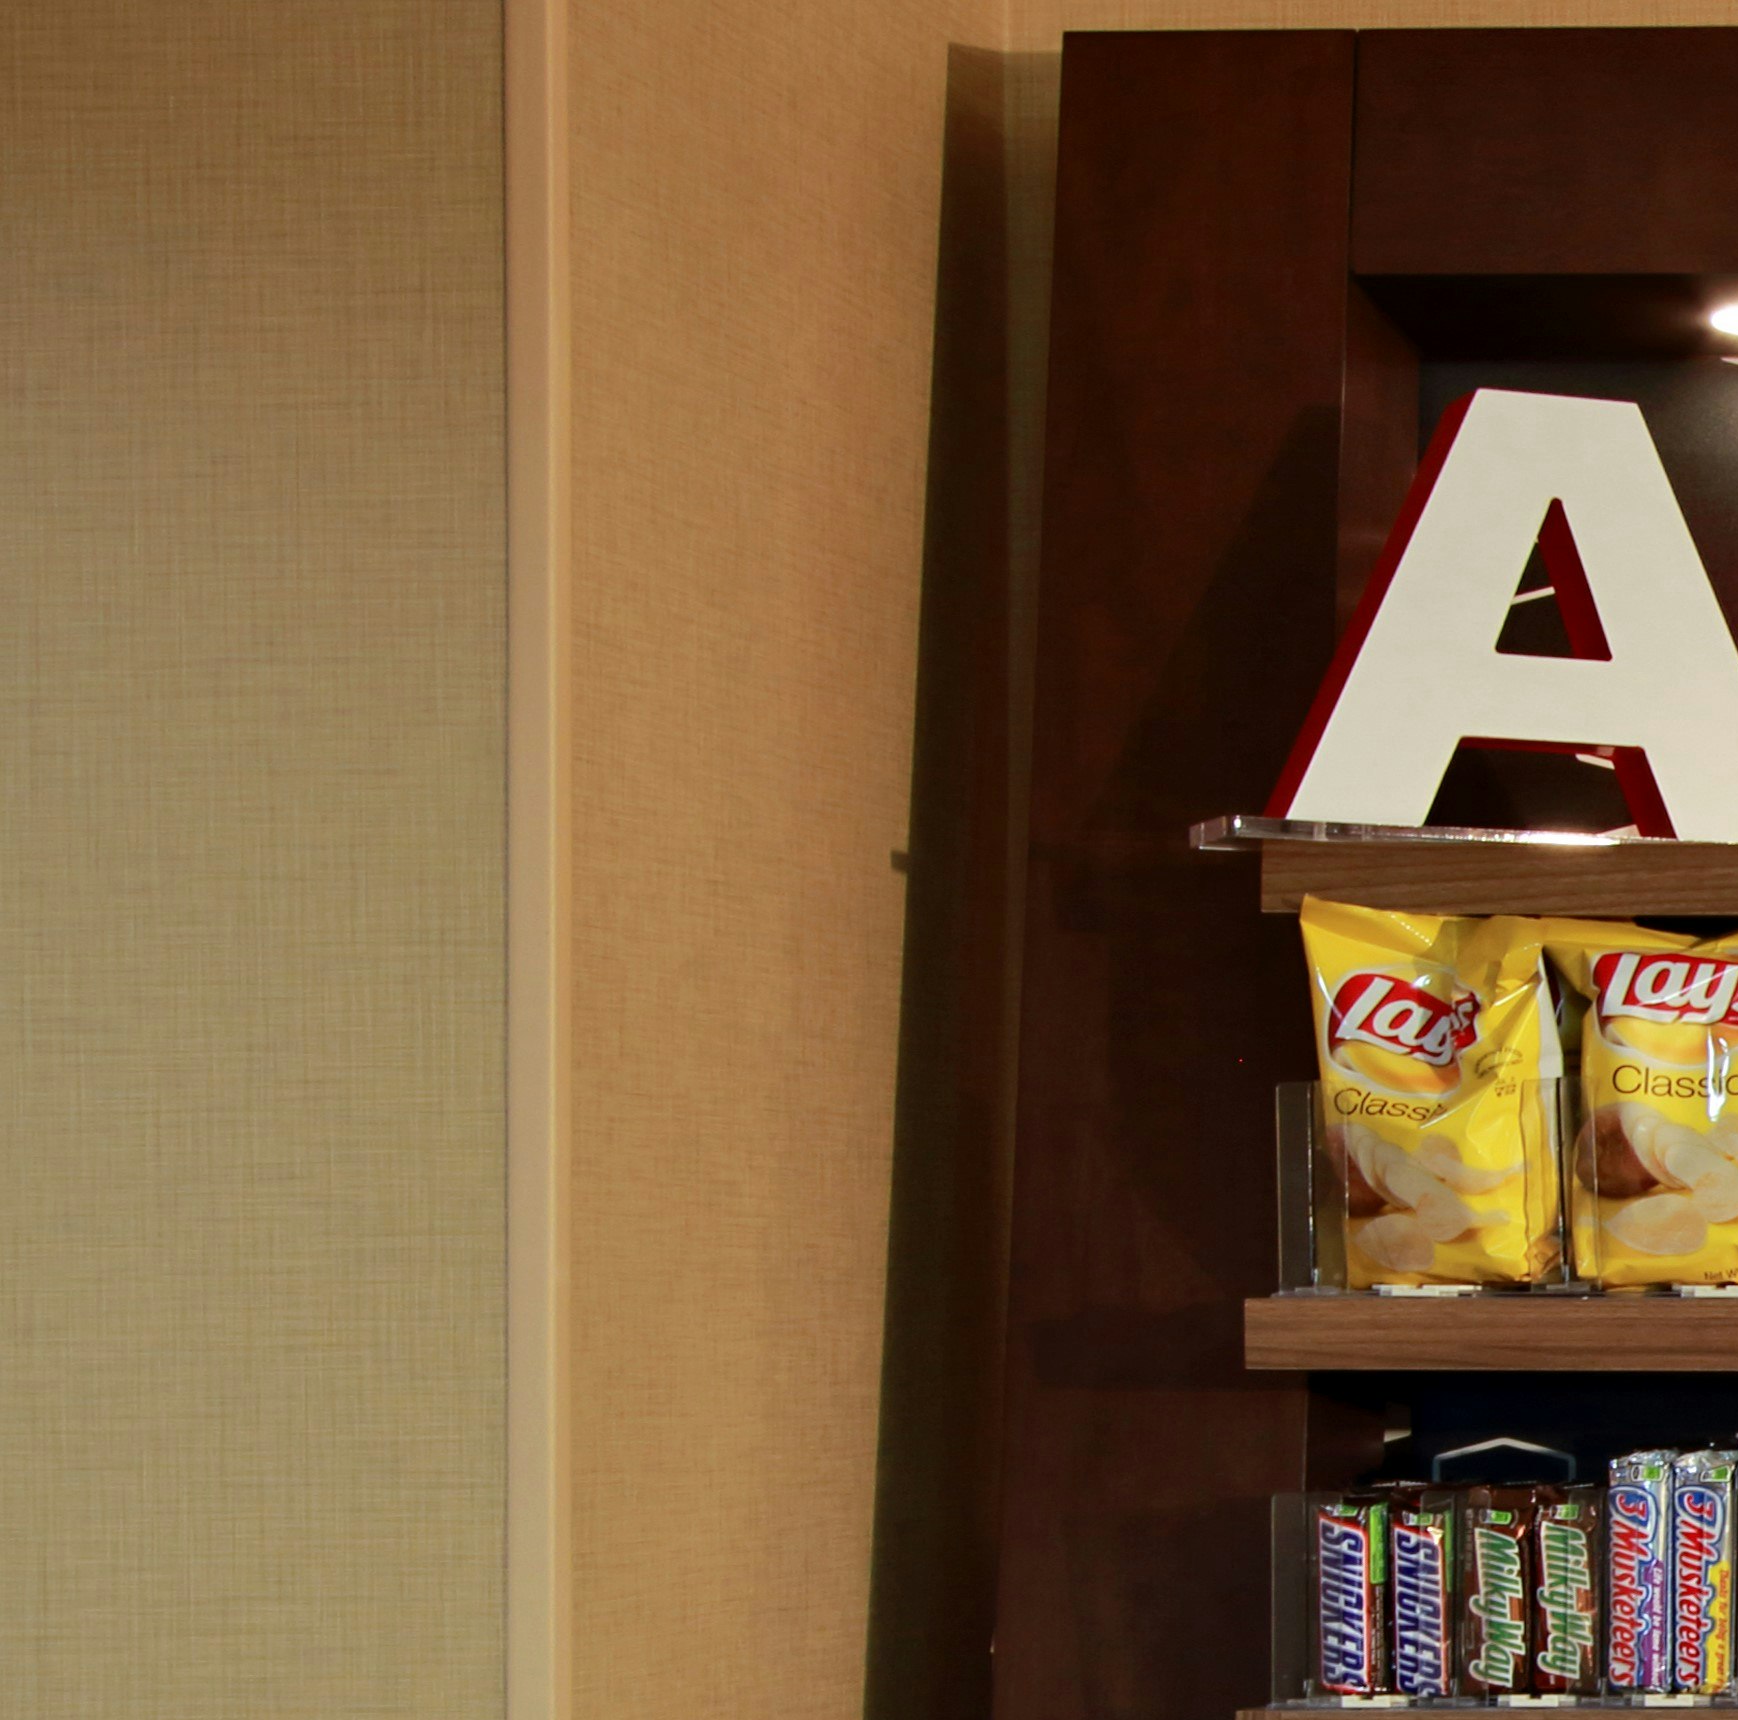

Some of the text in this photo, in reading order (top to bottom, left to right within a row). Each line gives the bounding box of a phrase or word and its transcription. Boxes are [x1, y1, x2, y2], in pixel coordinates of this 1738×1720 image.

[1319, 1518, 1367, 1690] SNICKERS
[1394, 1527, 1444, 1696] SNICKERS
[1470, 1527, 1526, 1687] Milky Way
[1537, 1520, 1594, 1680] Milky Way
[1610, 1492, 1650, 1687] 3 Musketeers
[1676, 1492, 1717, 1687] 3 Musketeers
